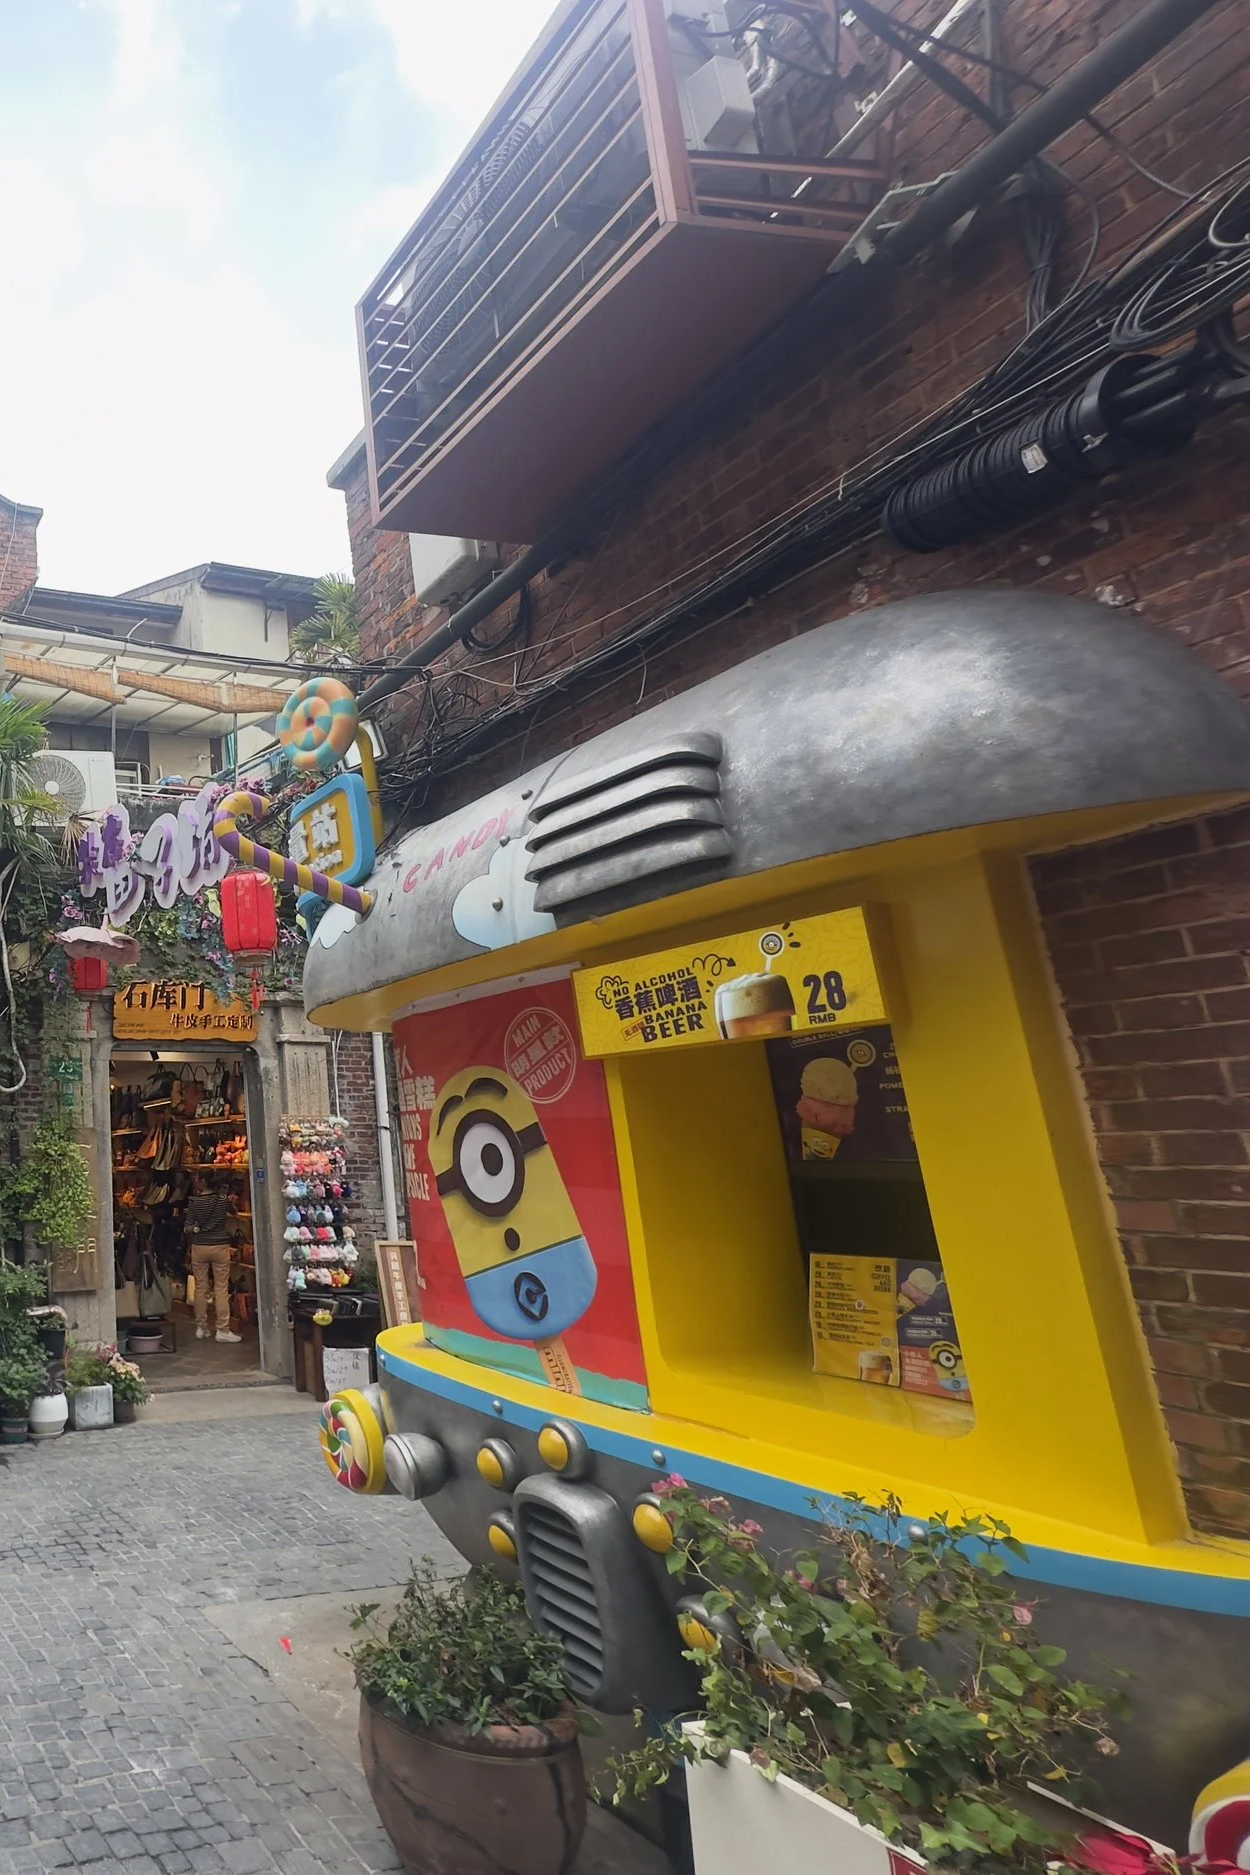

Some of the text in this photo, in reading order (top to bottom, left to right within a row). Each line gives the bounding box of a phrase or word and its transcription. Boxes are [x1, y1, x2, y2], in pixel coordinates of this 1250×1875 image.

[403, 803, 521, 893] CANDY
[122, 979, 207, 1011] 石库门
[613, 967, 694, 999] NO ALCOHOL
[615, 976, 702, 1020] 香蕉啤酒
[803, 970, 847, 1014] 28
[170, 1013, 253, 1030] 牛皮手工定制
[641, 1012, 705, 1043] BEER
[644, 1001, 708, 1025] BANANA
[809, 1012, 837, 1025] RMB
[511, 1014, 541, 1048] MAIN
[523, 1047, 572, 1096] PRODUCT
